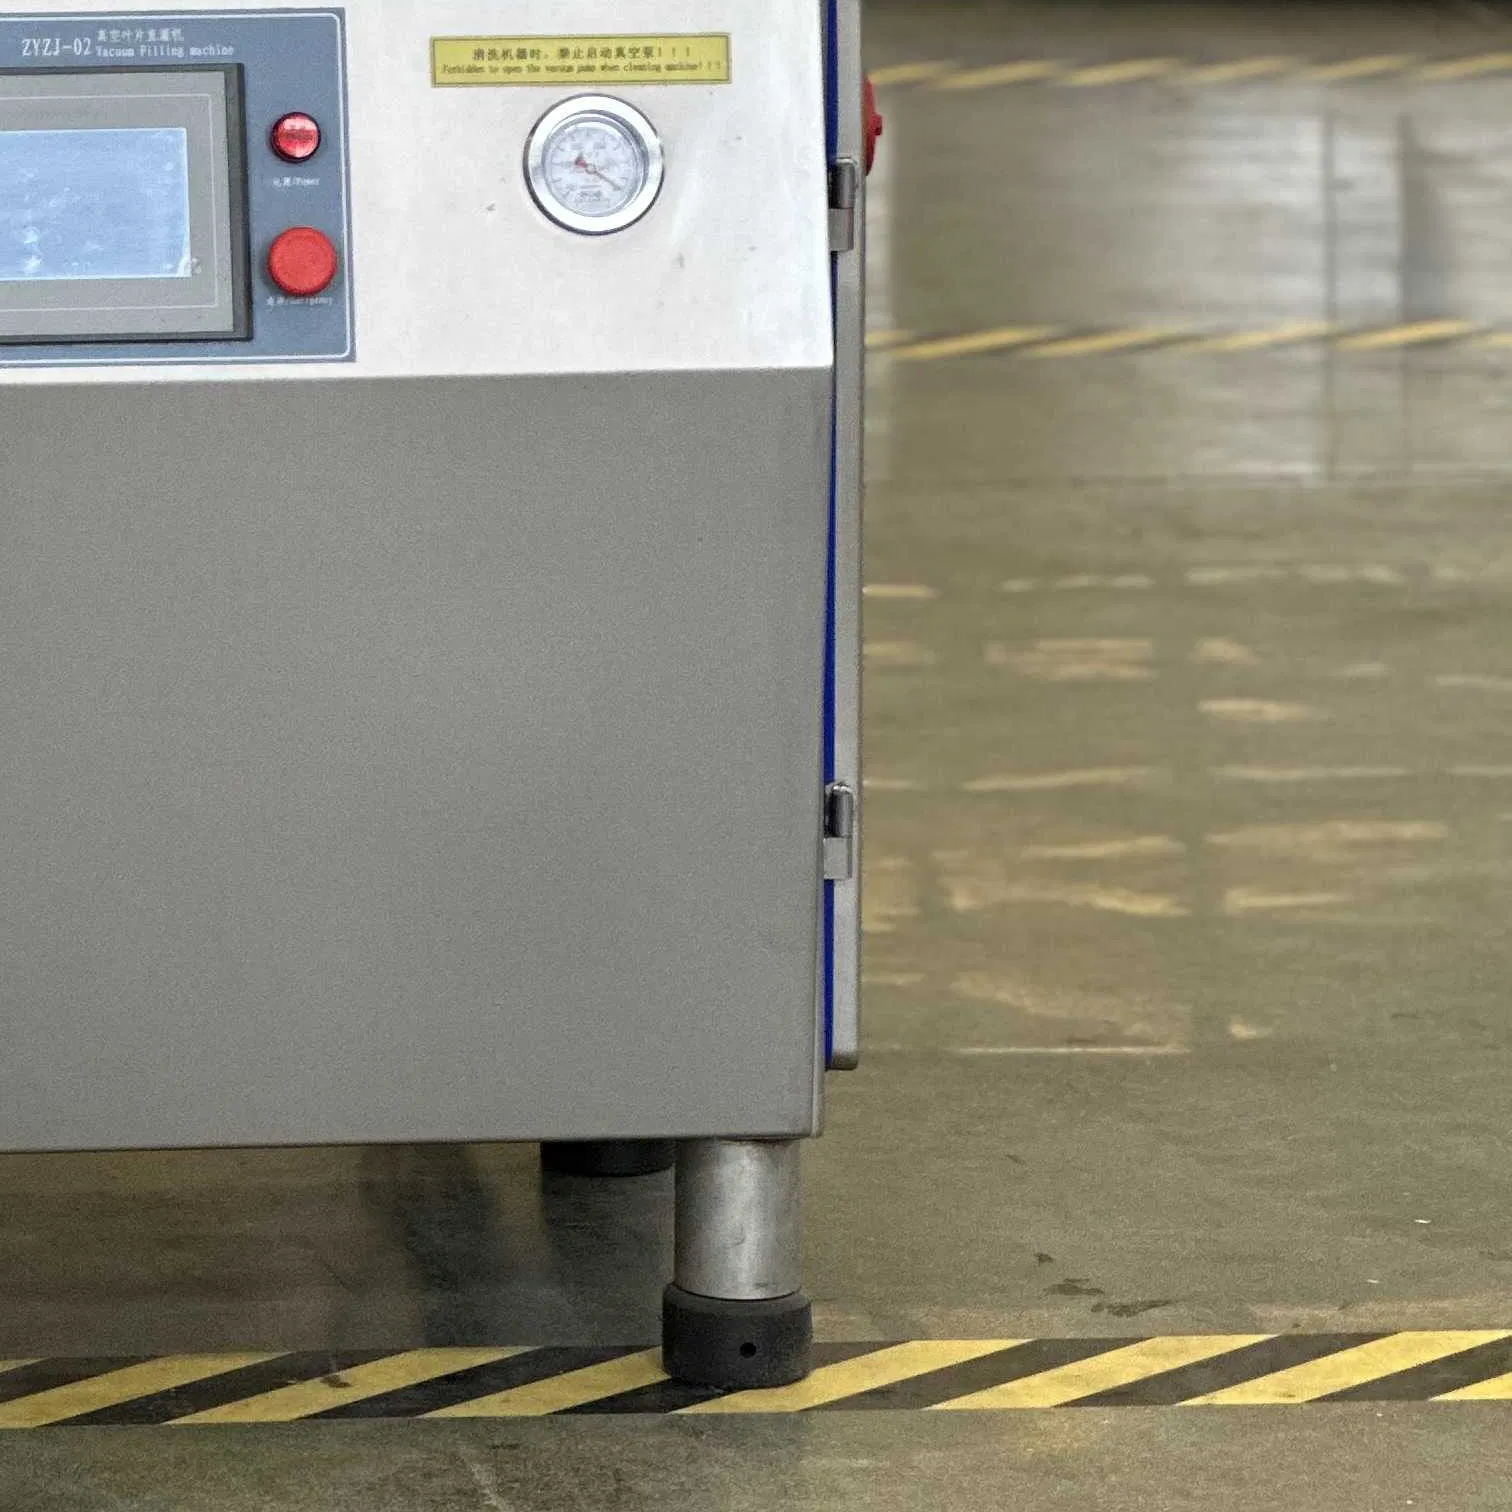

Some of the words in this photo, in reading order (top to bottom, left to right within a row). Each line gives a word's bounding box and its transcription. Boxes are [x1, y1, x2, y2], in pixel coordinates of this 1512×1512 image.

[21, 37, 92, 57] ZYZJ-02
[96, 45, 135, 58] Vacuum
[140, 44, 185, 59] Filling
